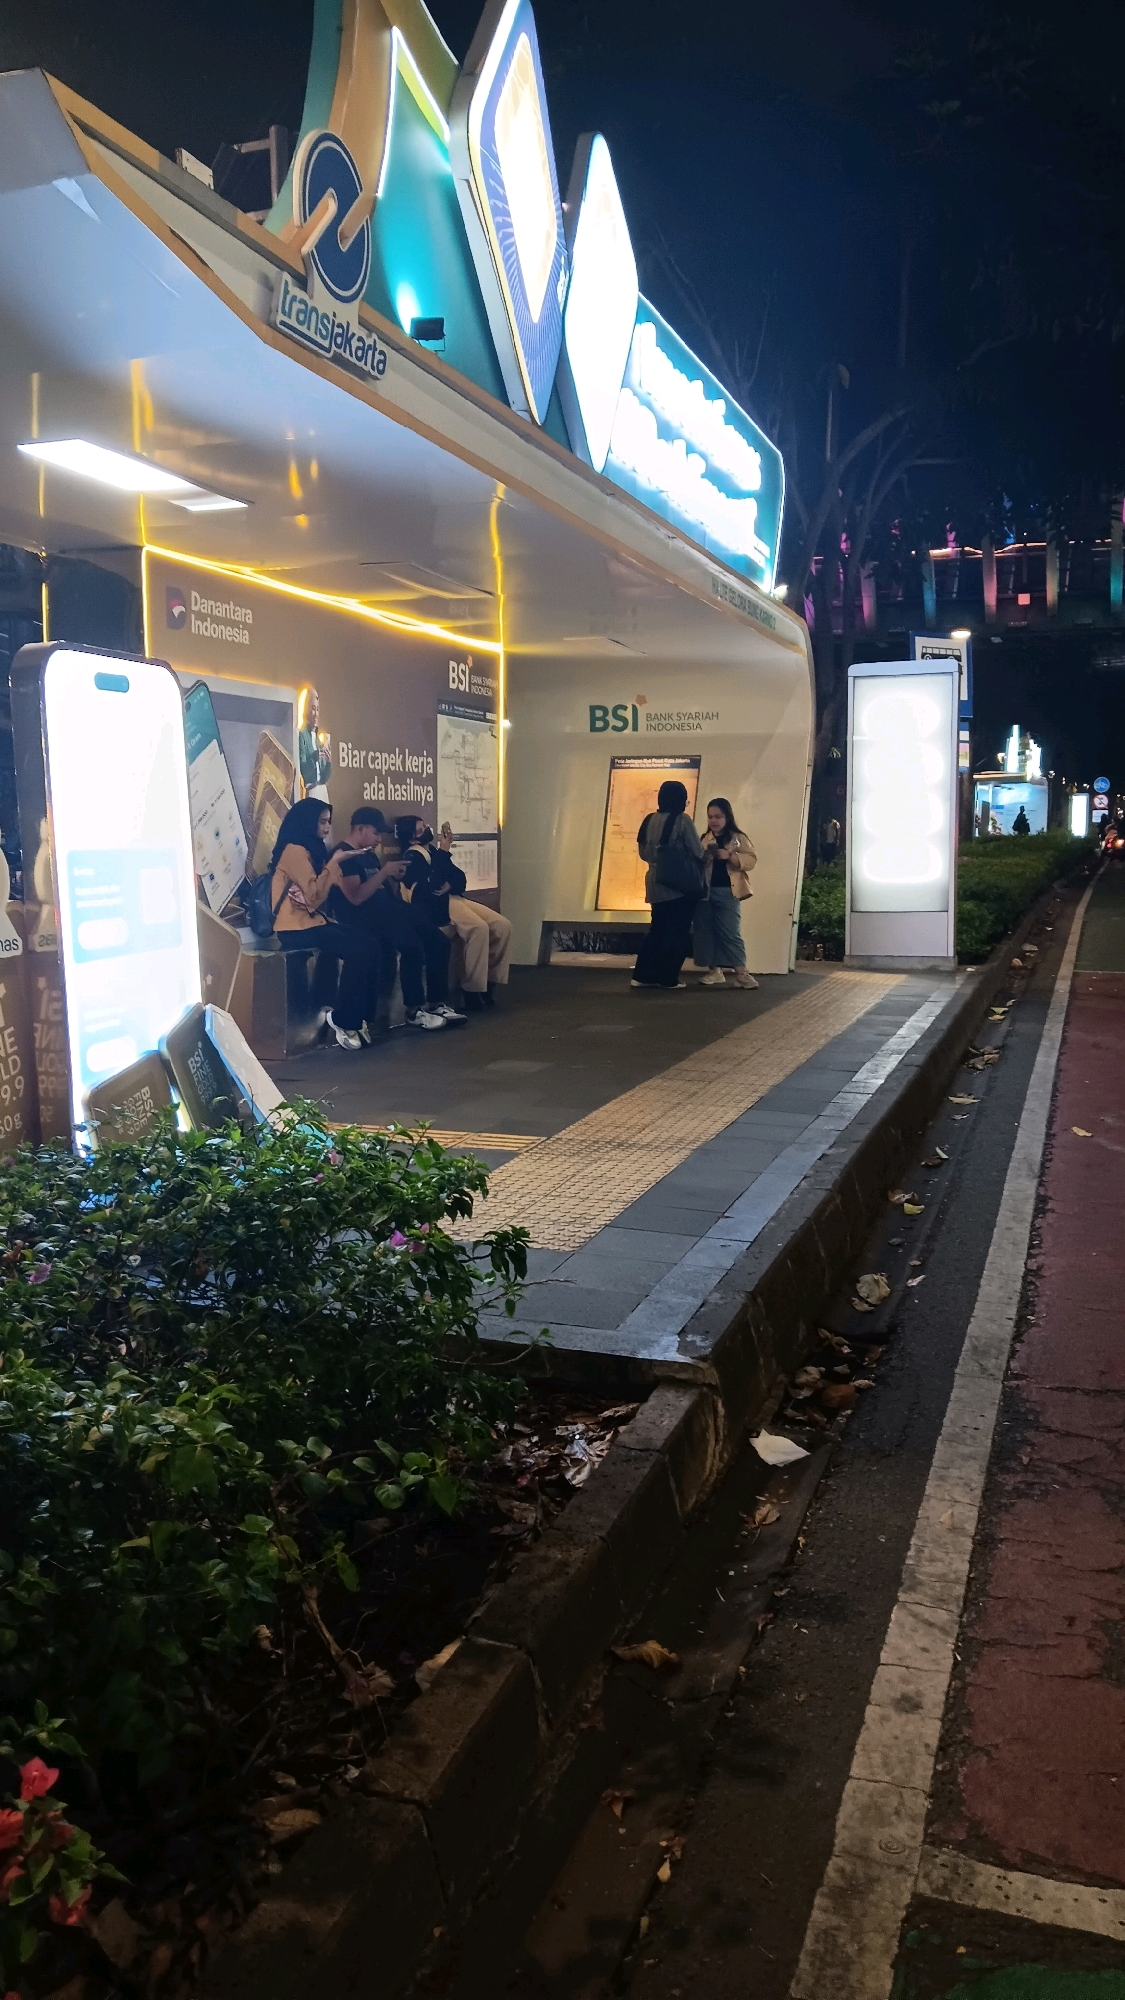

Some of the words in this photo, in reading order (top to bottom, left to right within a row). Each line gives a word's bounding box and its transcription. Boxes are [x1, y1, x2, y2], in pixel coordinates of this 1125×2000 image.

[280, 278, 387, 376] transjakarta
[191, 590, 253, 624] Danantara
[190, 613, 250, 645] Indonesia
[448, 660, 469, 693] BSI
[589, 703, 639, 733] BSI
[645, 712, 674, 722] BANK
[676, 711, 720, 721] SYARIAH
[645, 722, 703, 732] INDONESIA
[339, 741, 366, 769] Biar
[367, 747, 404, 776] capek
[405, 748, 434, 778] kerja
[363, 775, 386, 801] ada
[387, 776, 434, 807] hasilnya
[187, 1048, 205, 1075] BSI
